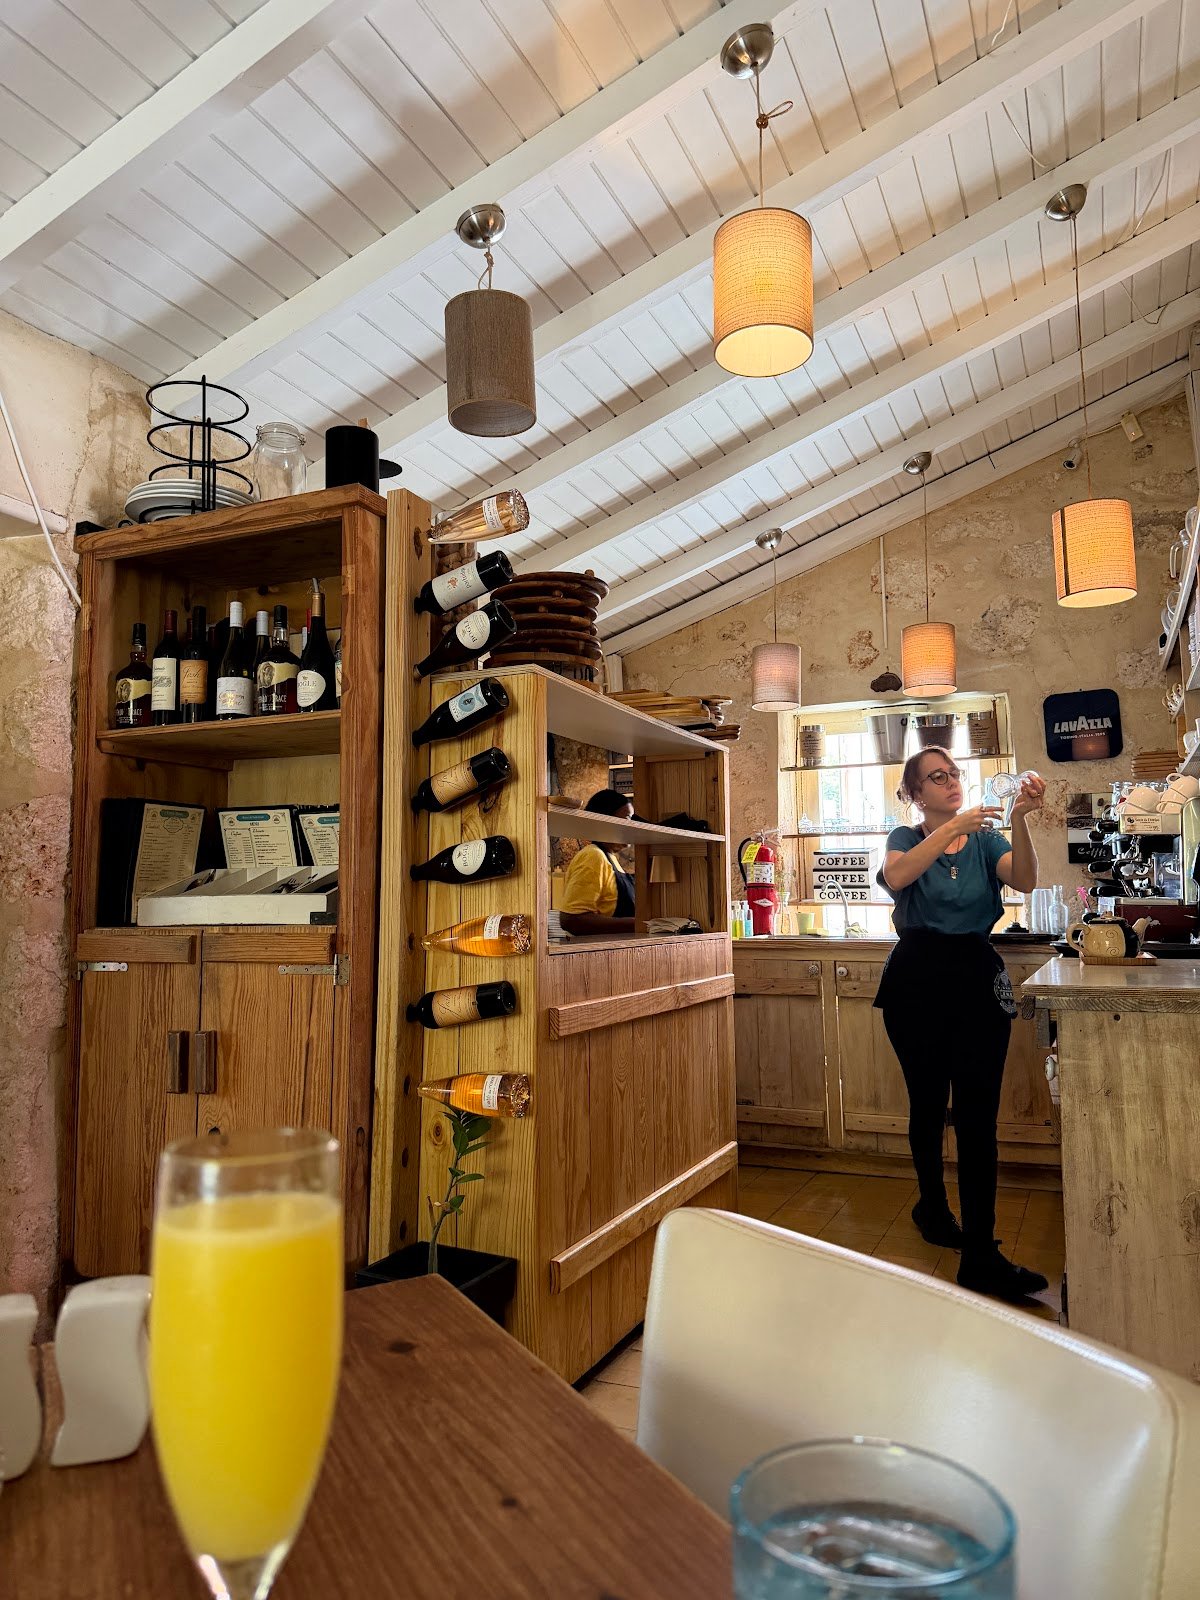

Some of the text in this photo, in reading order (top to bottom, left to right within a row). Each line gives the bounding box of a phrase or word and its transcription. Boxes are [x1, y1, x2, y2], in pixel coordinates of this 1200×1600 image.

[1054, 715, 1113, 733] LAVAZZA
[818, 857, 866, 866] COFFEE
[818, 874, 866, 883] COFFEE
